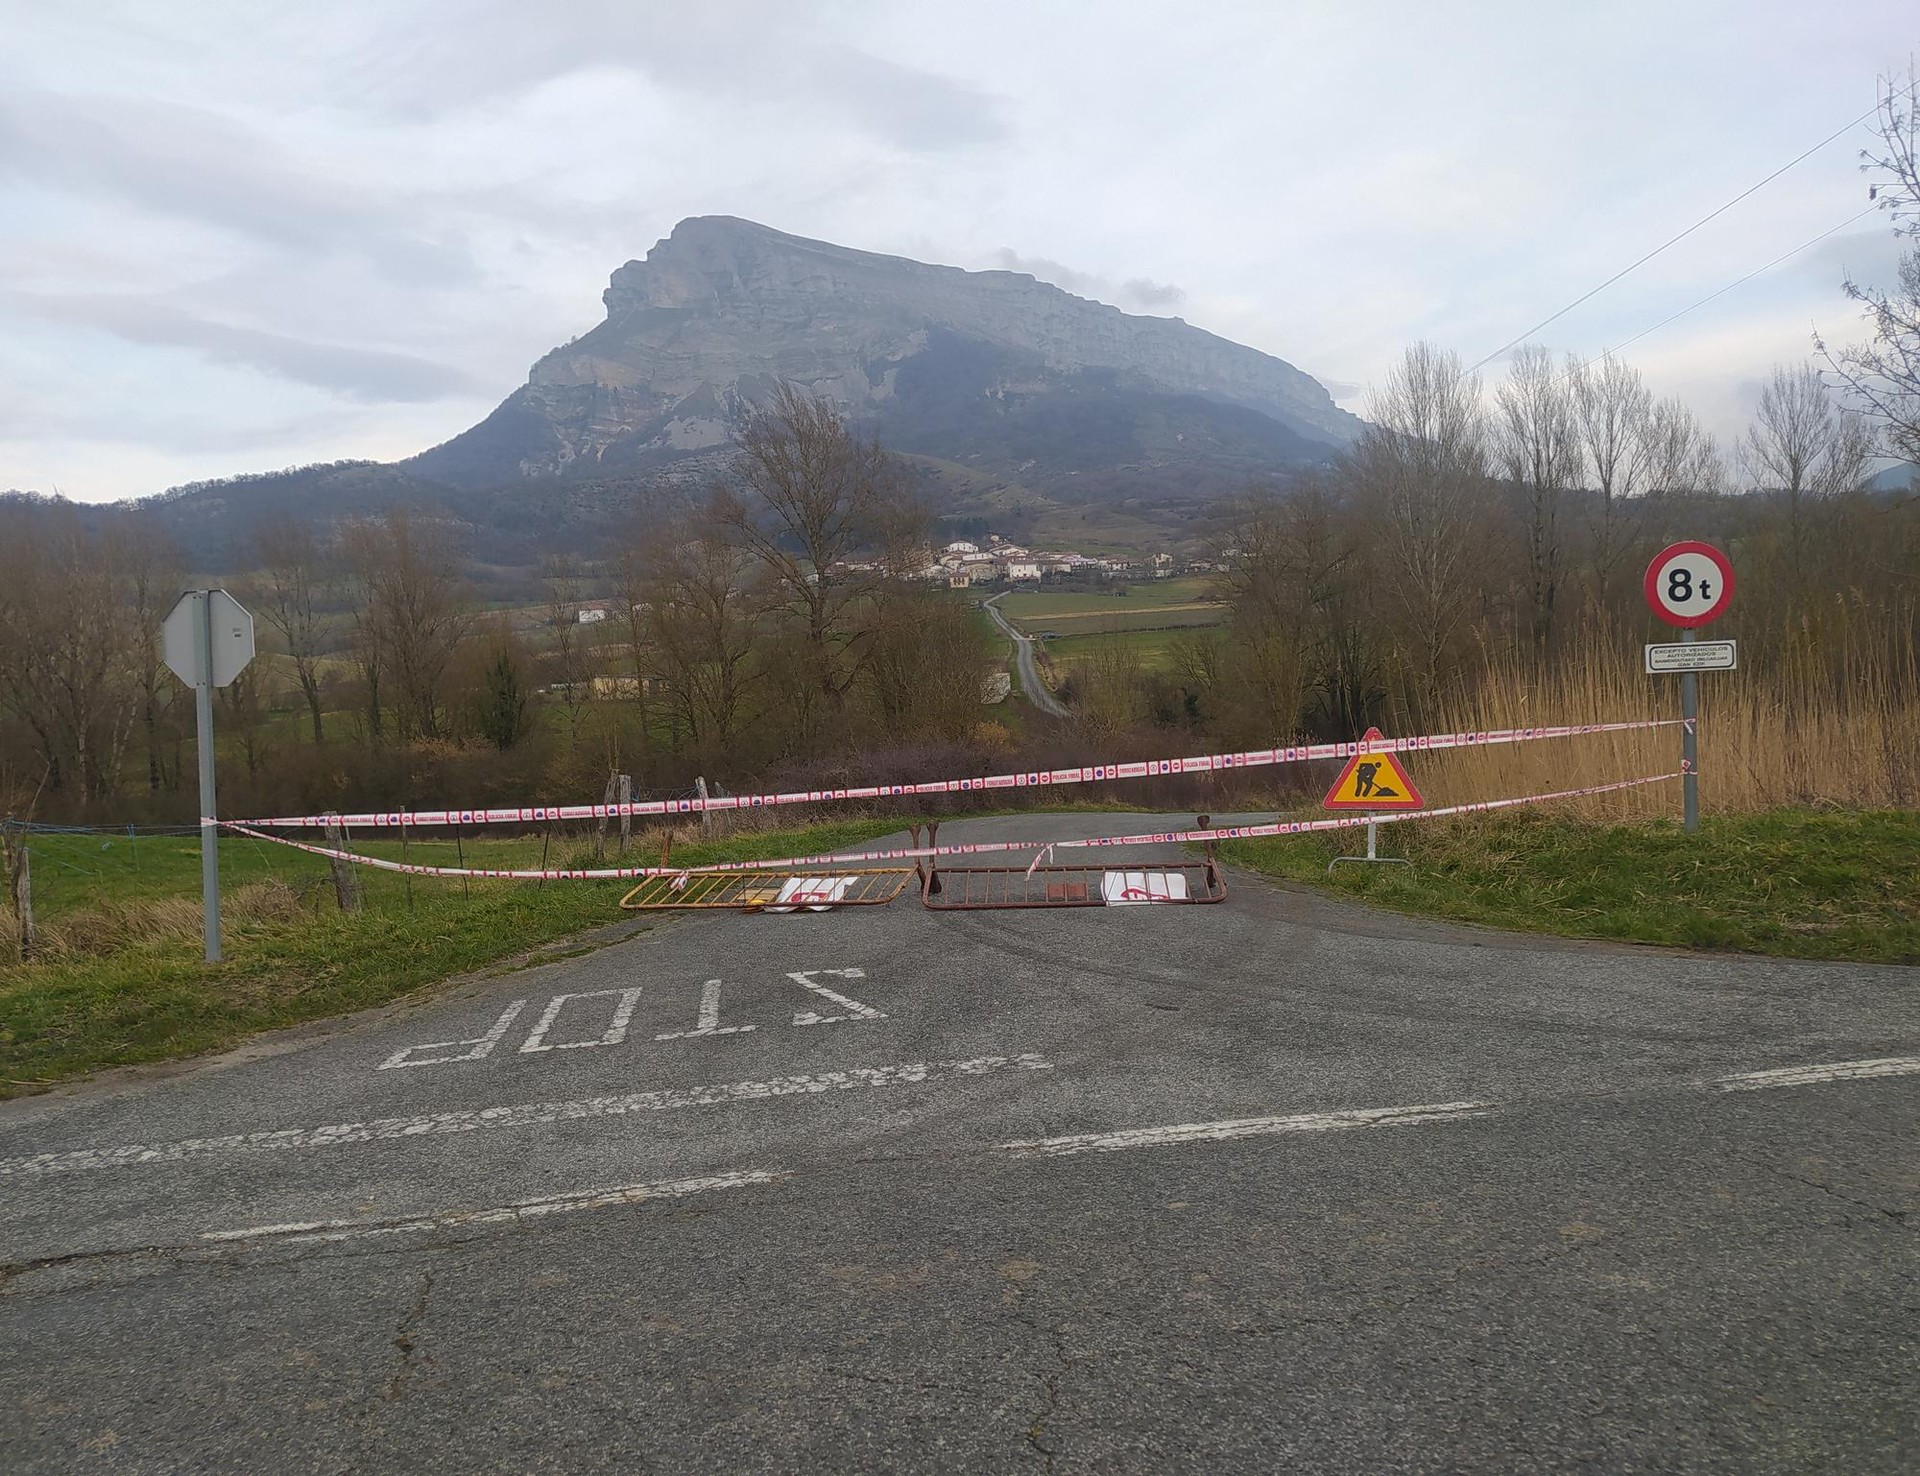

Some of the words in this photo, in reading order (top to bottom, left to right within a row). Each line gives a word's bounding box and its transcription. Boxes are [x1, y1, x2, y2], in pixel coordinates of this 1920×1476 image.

[1668, 568, 1693, 602] 8
[1699, 579, 1711, 600] t
[376, 968, 888, 1070] STOP
